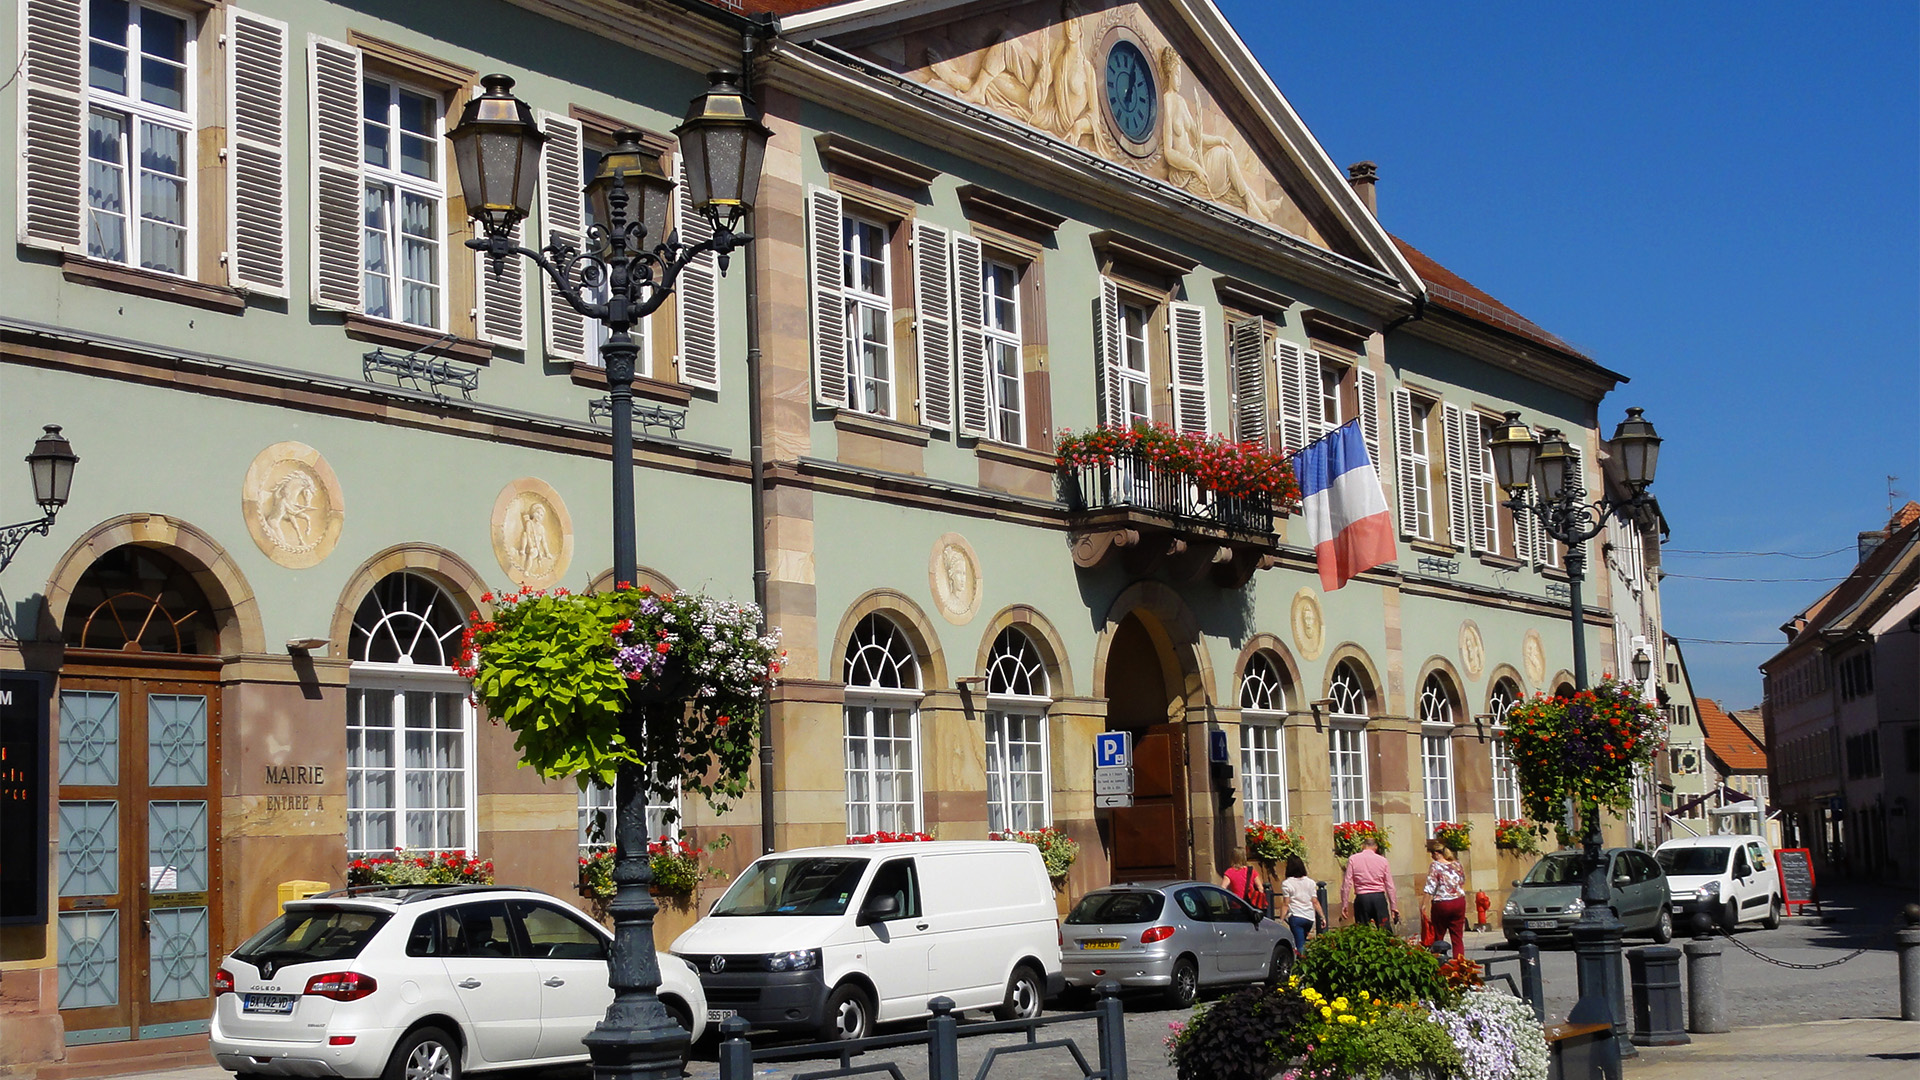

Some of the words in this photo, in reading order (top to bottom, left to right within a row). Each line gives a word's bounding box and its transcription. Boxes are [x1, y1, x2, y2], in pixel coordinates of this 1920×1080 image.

[1104, 739, 1117, 761] P
[265, 765, 325, 785] MAIRIE
[266, 796, 309, 811] ENTREE
[317, 797, 324, 811] A
